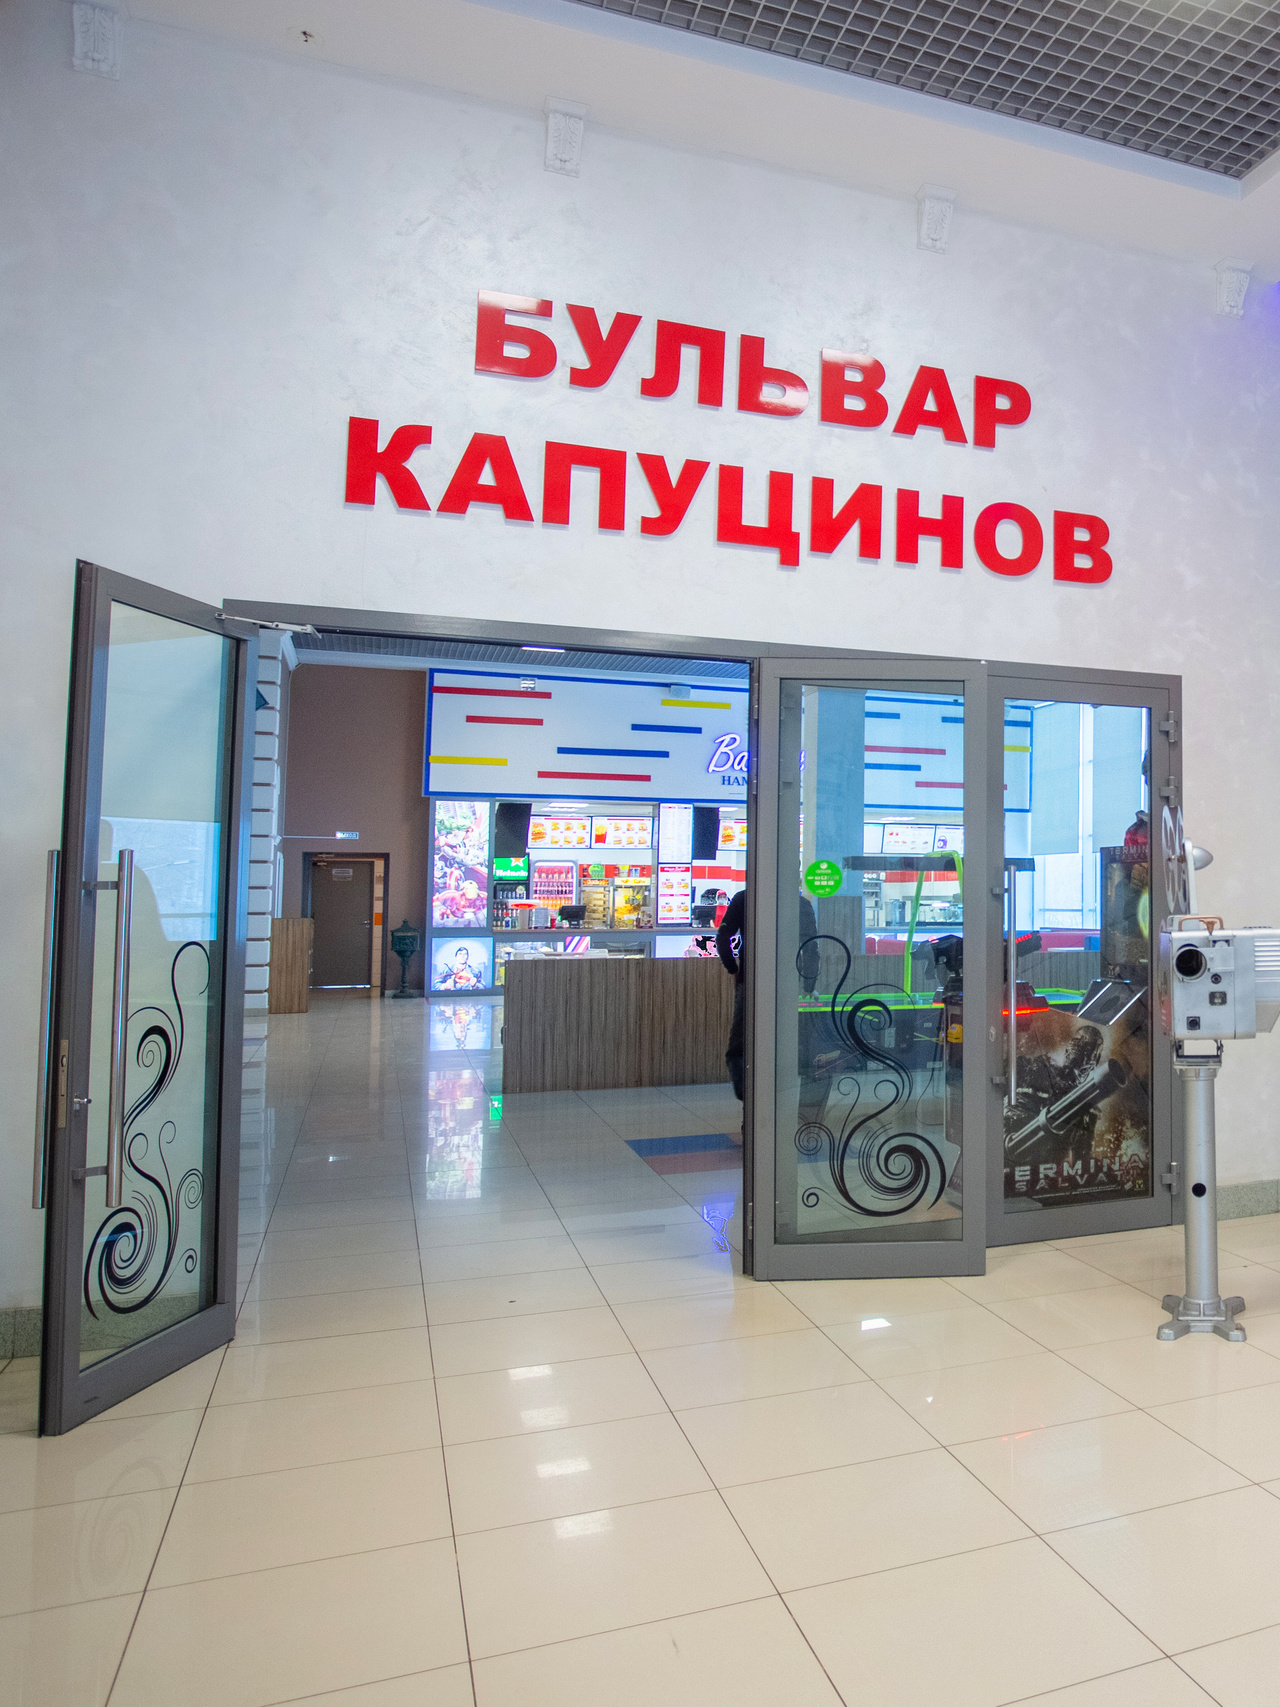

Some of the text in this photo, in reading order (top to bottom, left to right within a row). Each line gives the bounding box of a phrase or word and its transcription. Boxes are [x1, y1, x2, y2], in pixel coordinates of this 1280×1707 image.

[474, 290, 1032, 448] БУЛЬВАР
[344, 416, 1114, 583] КАПУЦИНОВ
[1003, 1153, 1144, 1181] ERMINA
